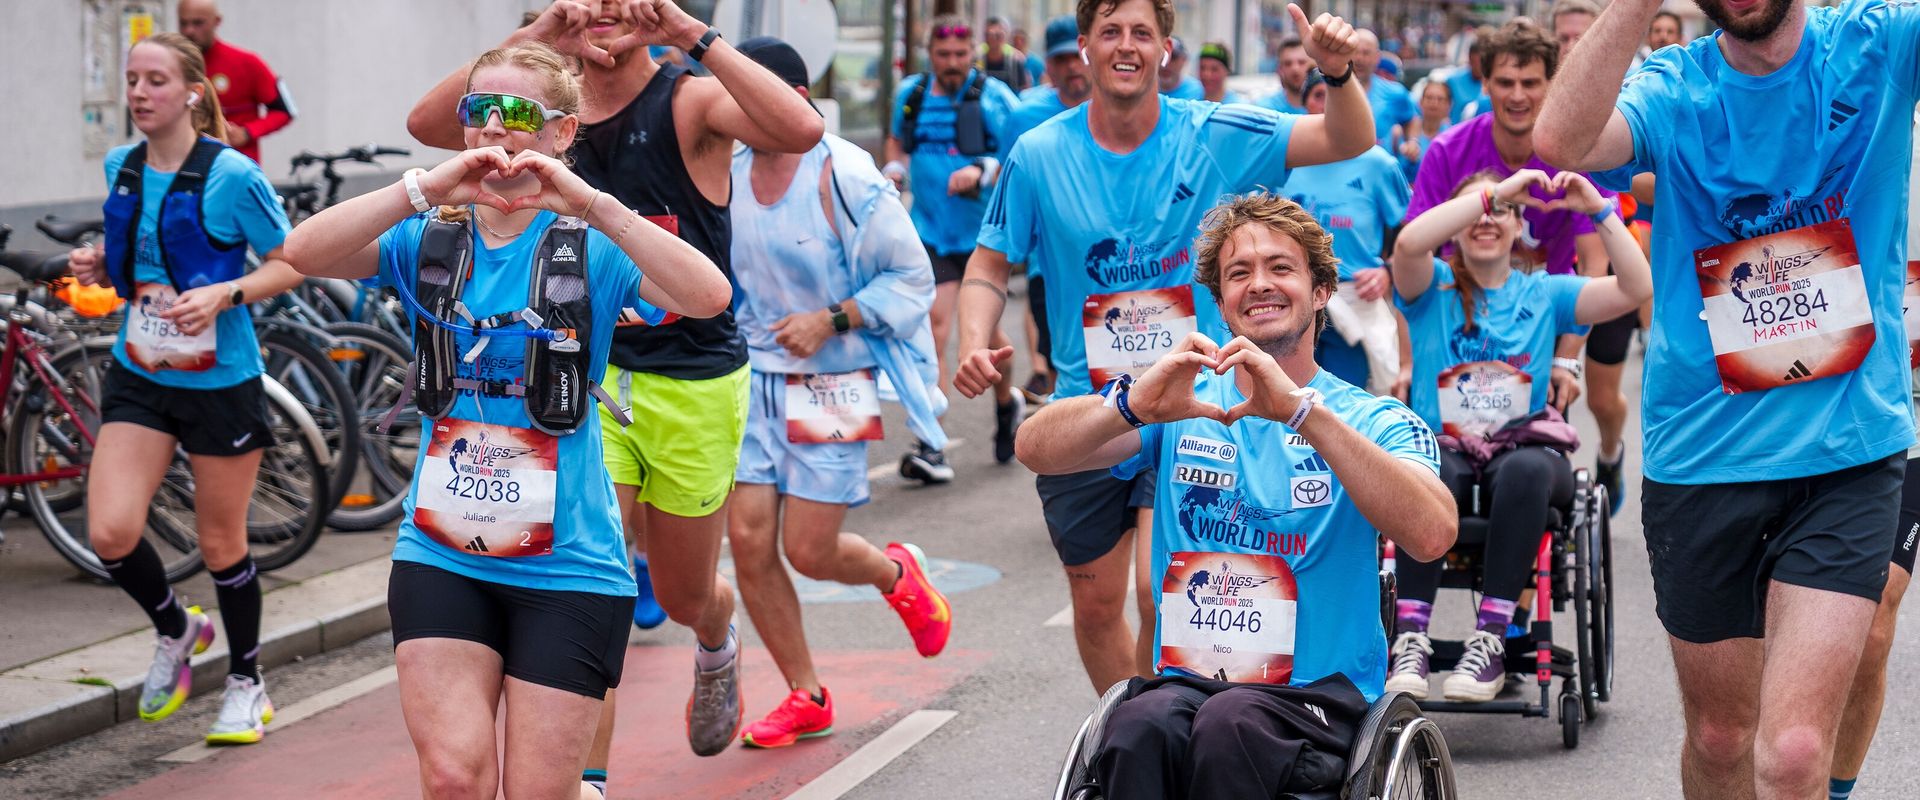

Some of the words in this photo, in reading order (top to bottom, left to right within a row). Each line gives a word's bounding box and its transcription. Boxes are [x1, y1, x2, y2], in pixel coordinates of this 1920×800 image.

[1754, 256, 1802, 276] WINGS
[1765, 270, 1790, 285] LIFE
[1791, 278, 1811, 291] 2025
[1742, 288, 1829, 327] 48284
[141, 320, 185, 336] 4183
[1754, 318, 1818, 343] MARTIN
[1111, 331, 1173, 352] 46273
[560, 371, 569, 411] AONIJIE
[808, 388, 860, 406] 47115
[1460, 394, 1512, 410] 42365
[469, 443, 511, 458] WINGS
[1179, 438, 1218, 455] Allianz
[472, 456, 494, 467] LIFE
[493, 468, 511, 478] 2025
[1176, 466, 1235, 487] RADO
[445, 474, 521, 503] 42038
[462, 511, 497, 523] Juliane
[1219, 499, 1264, 519] WINGS
[1223, 510, 1250, 526] LIFE
[519, 530, 531, 547] 2
[1902, 522, 1920, 551] FUSION
[1211, 573, 1253, 587] WINGS
[1216, 586, 1241, 597] LIFE
[1238, 599, 1254, 608] 2025
[1189, 607, 1262, 633] 44046
[1213, 644, 1232, 654] Nico
[1260, 662, 1268, 679] 1
